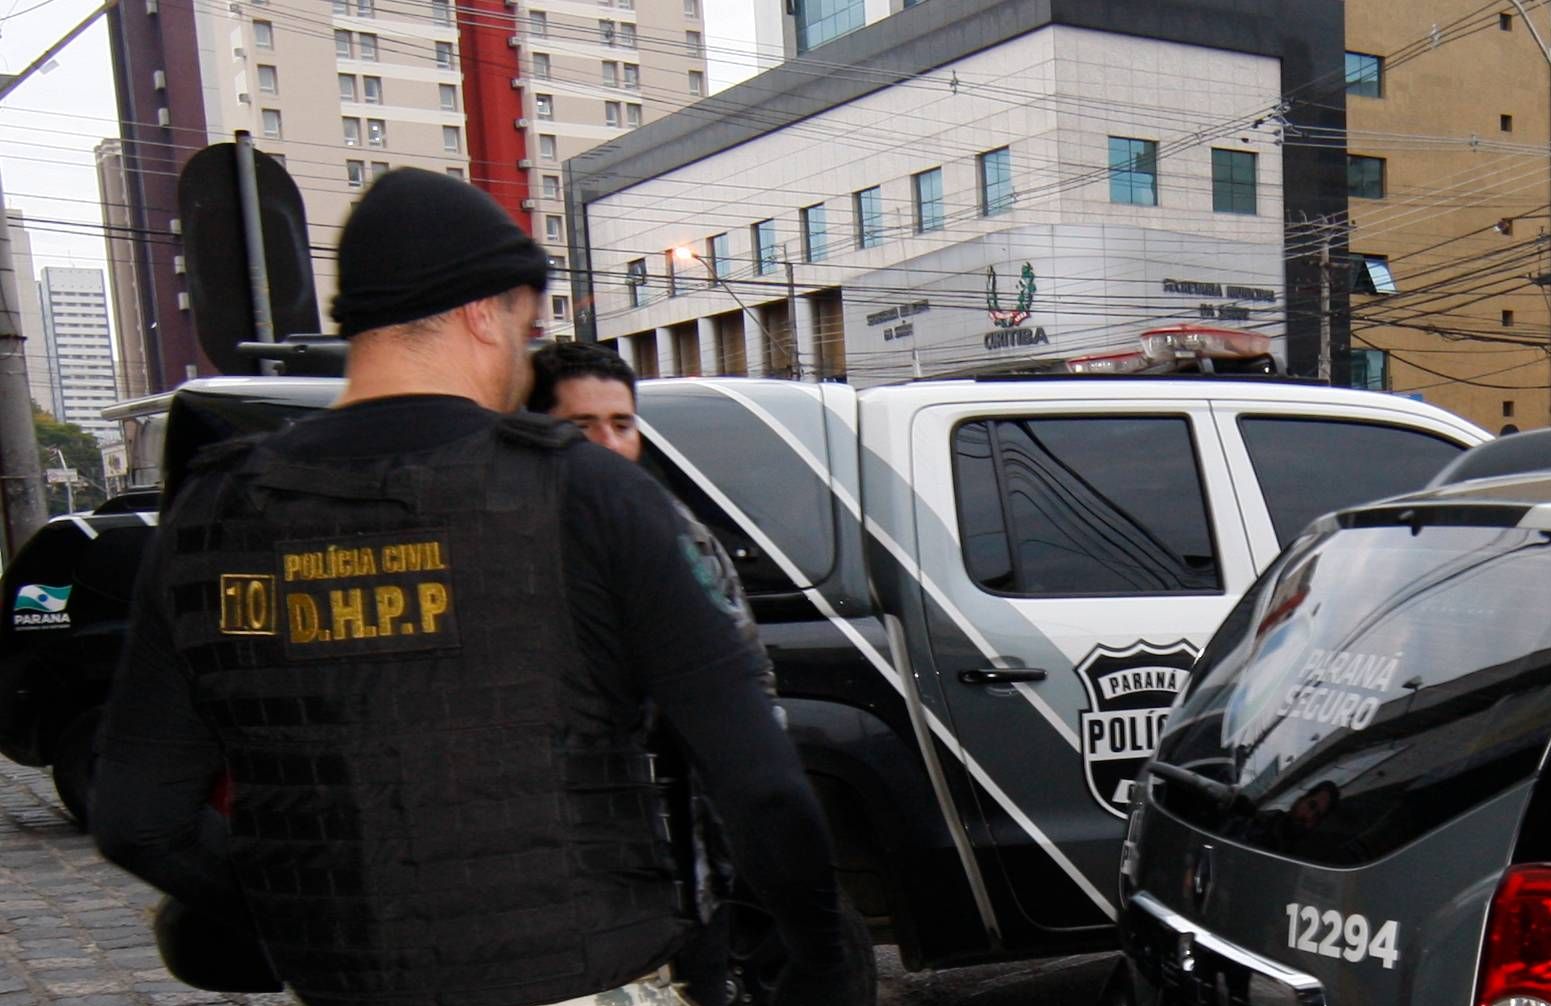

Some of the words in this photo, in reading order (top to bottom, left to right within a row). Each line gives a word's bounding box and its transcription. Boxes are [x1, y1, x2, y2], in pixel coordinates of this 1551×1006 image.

[283, 545, 377, 582] POLÍCIA
[382, 542, 446, 572] CIVIL
[226, 580, 267, 629] 10
[1109, 669, 1177, 694] PARANÁ
[1297, 649, 1403, 693] PARANÁ
[1277, 684, 1382, 731] SEGURO
[1286, 902, 1400, 969] 12294
